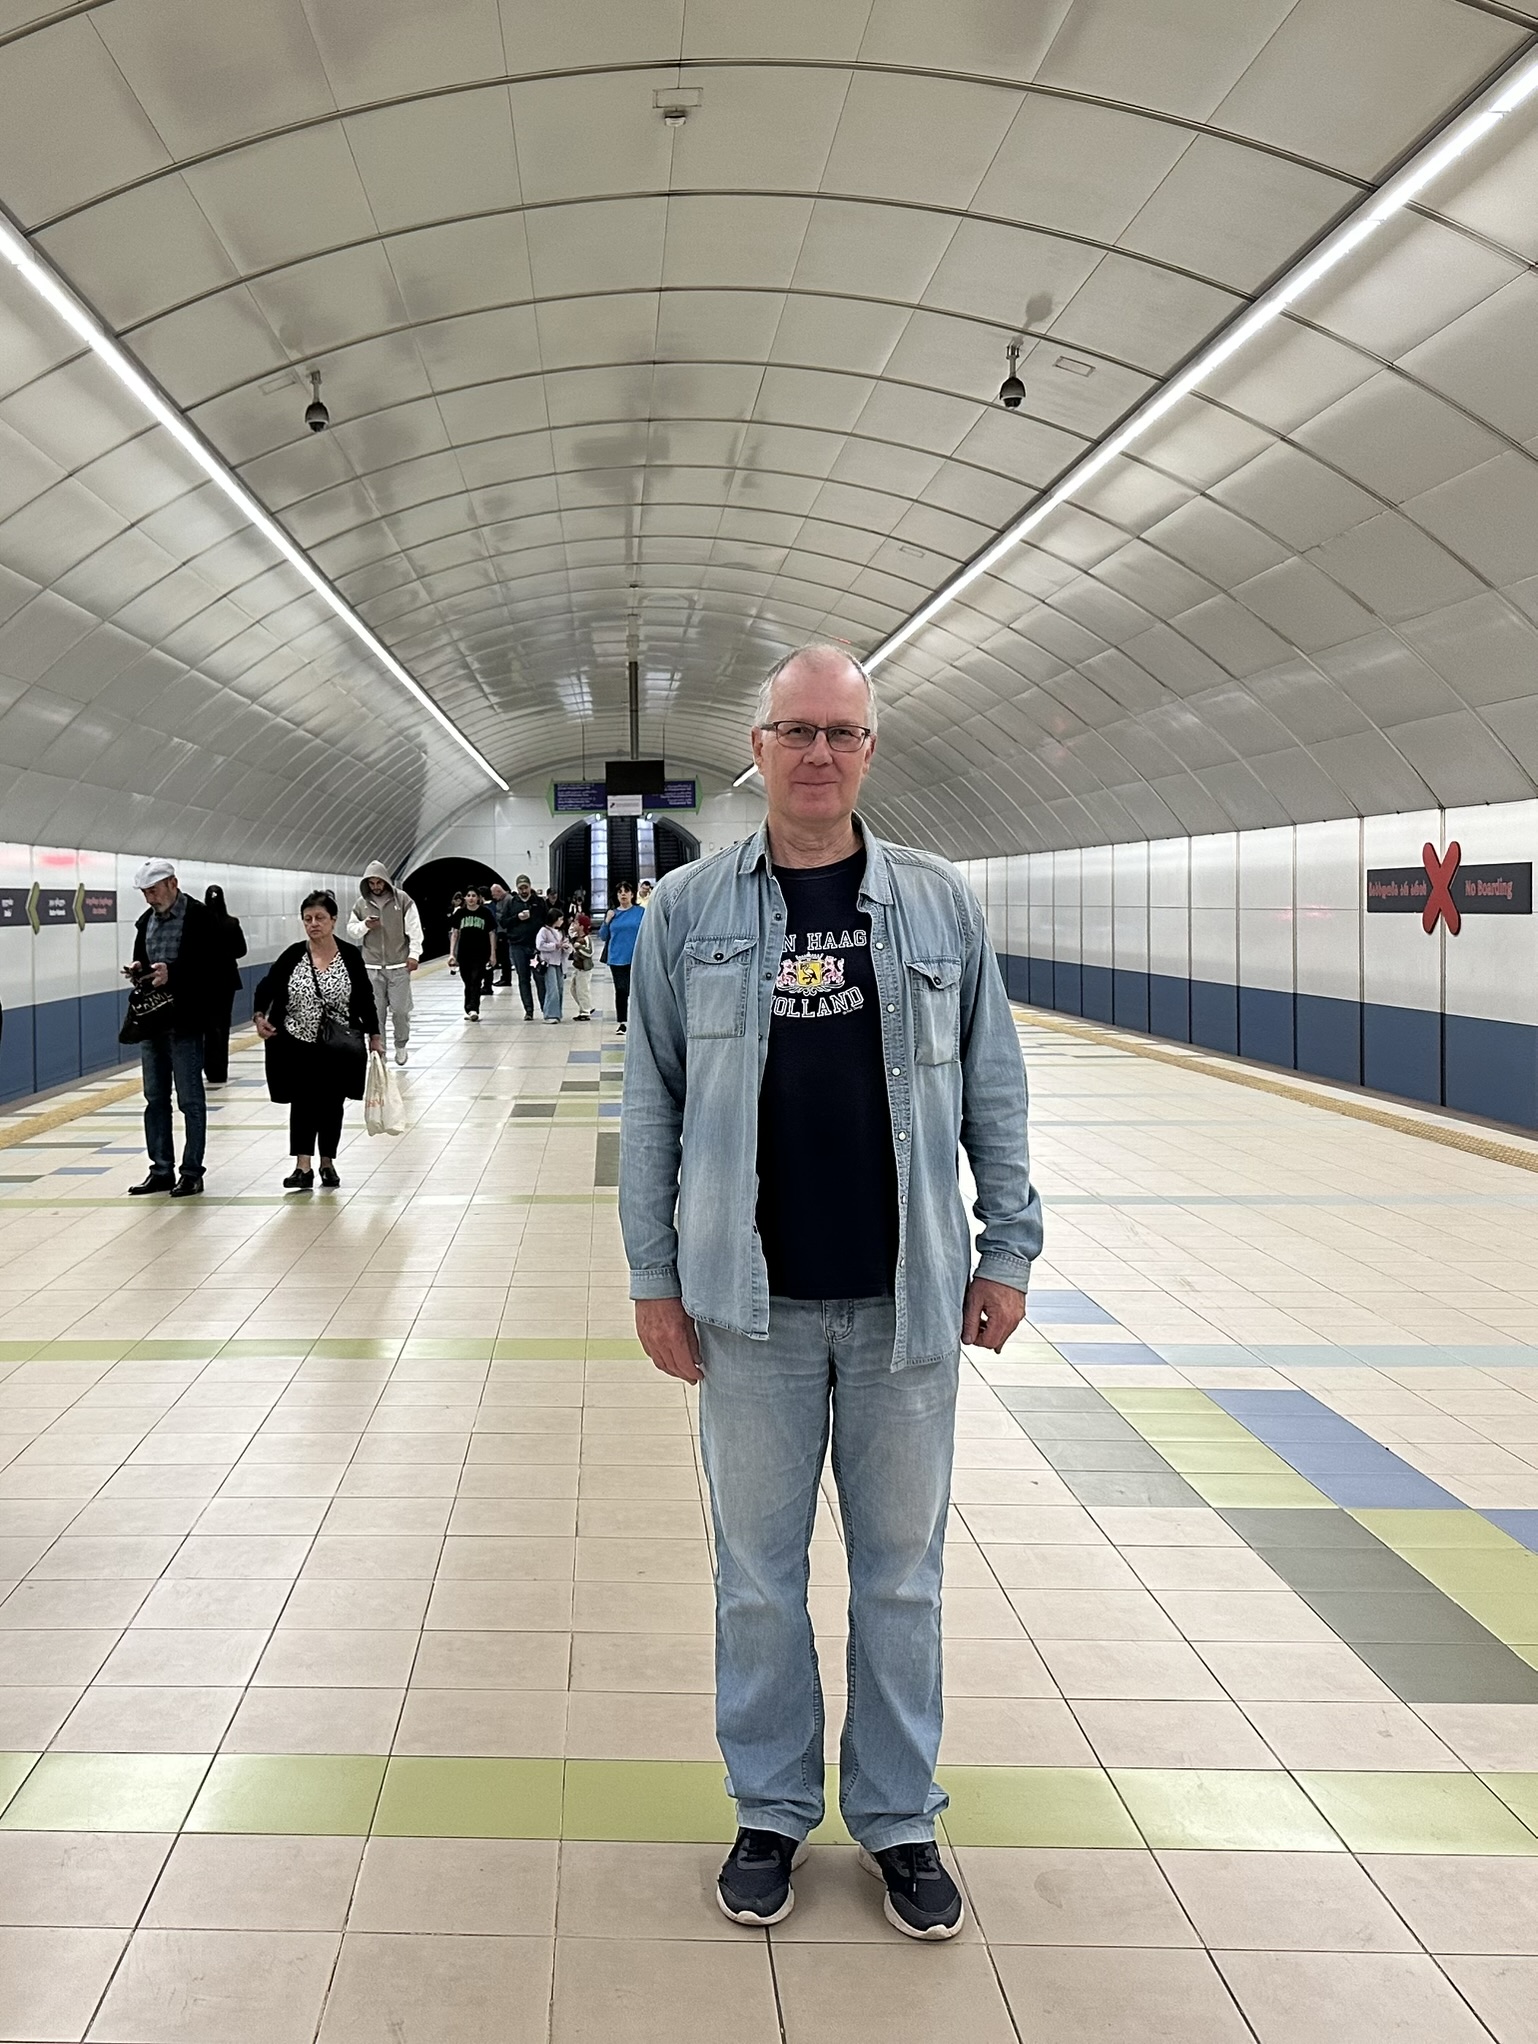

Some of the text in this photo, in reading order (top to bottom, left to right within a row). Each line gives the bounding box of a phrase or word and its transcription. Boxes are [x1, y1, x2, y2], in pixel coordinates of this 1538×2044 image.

[1465, 877, 1513, 900] No Boarding
[782, 929, 867, 952] N HAAG
[771, 986, 864, 1018] OLLAND
